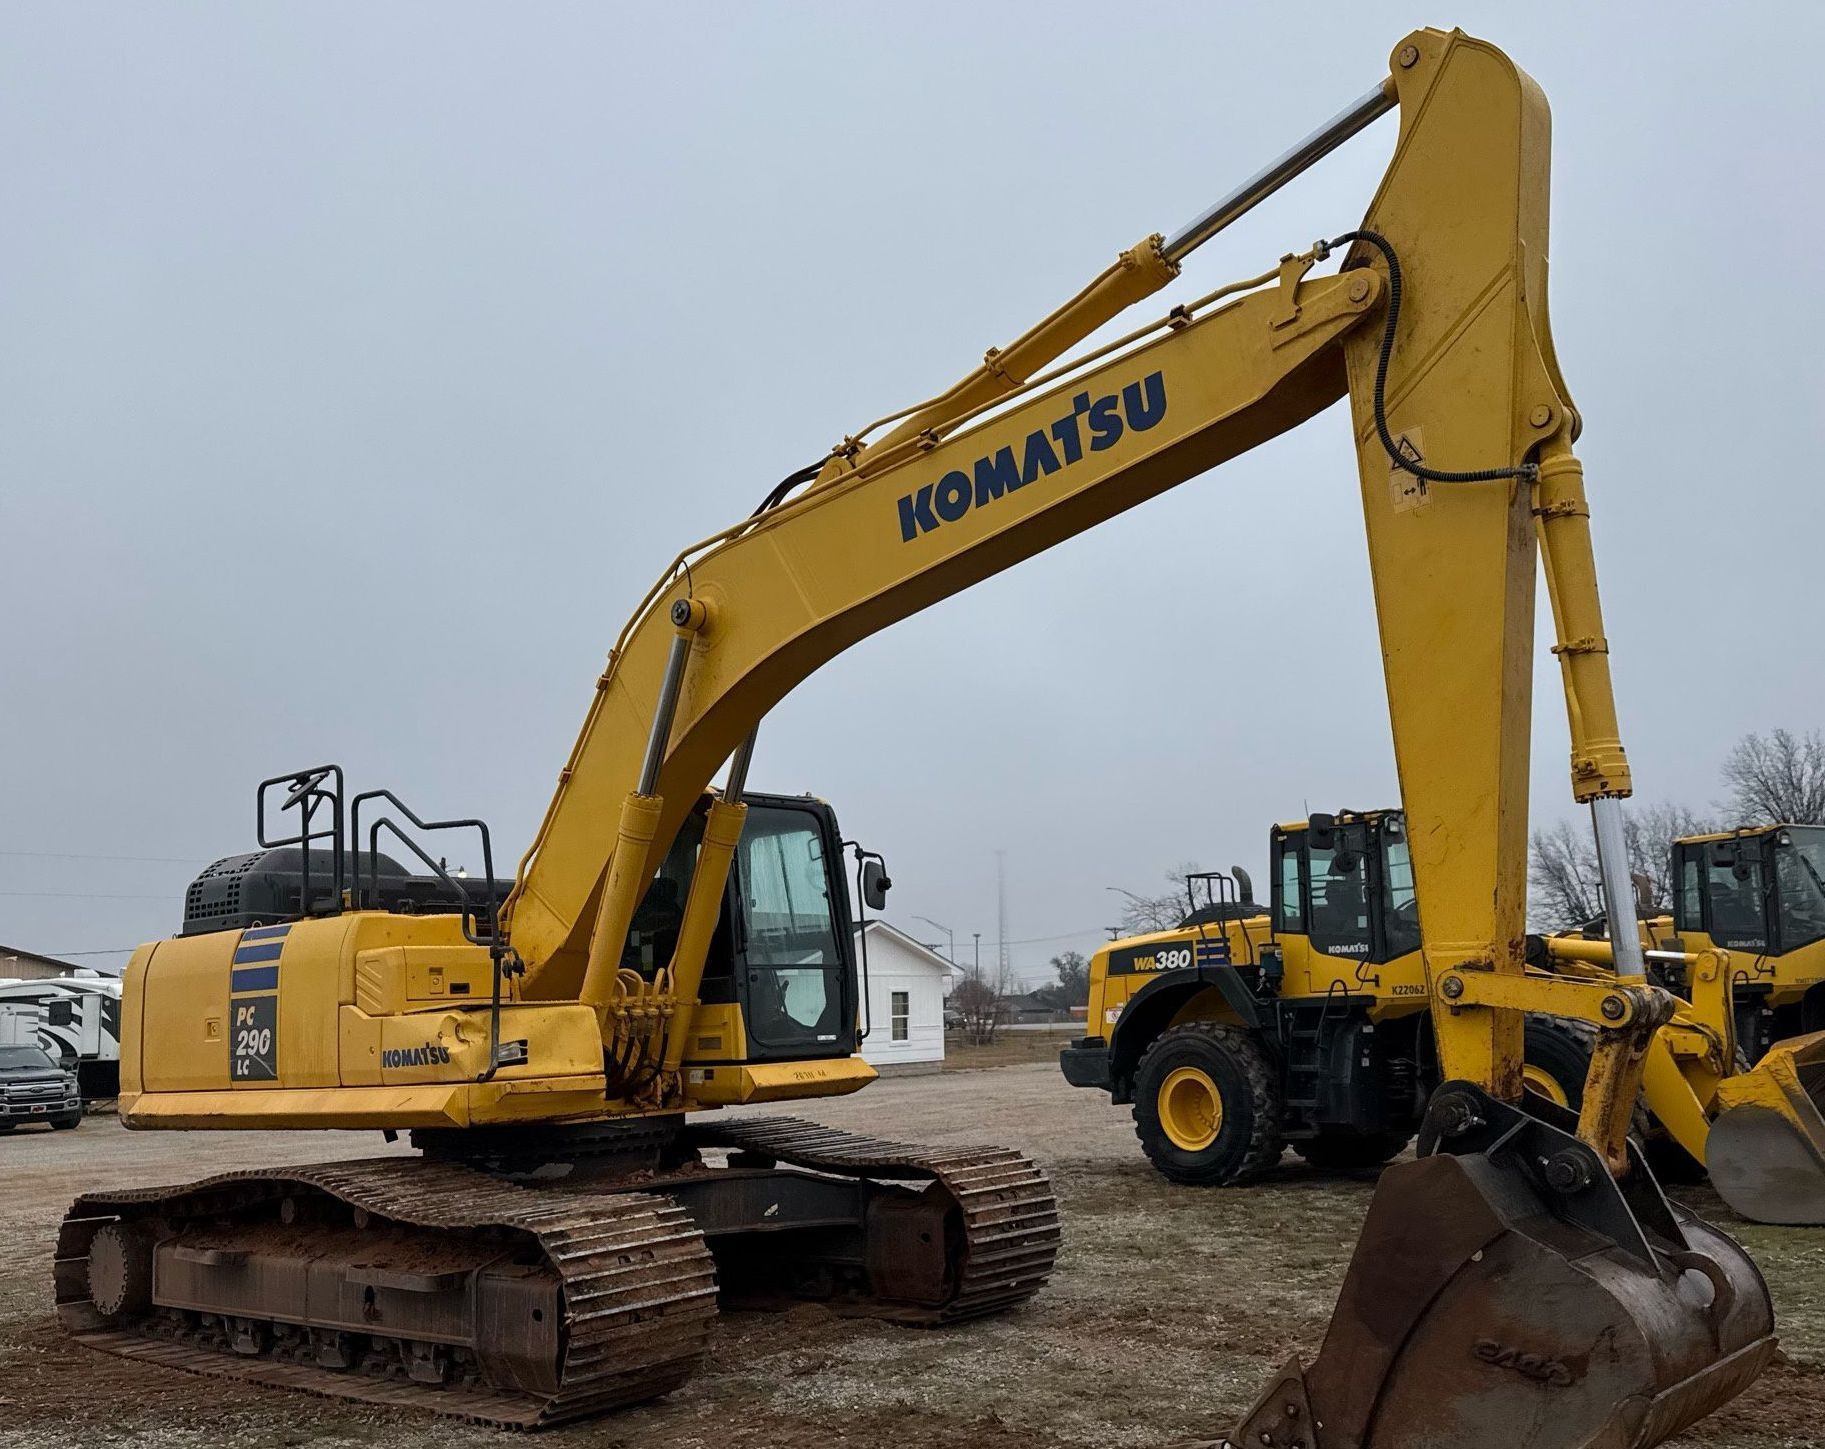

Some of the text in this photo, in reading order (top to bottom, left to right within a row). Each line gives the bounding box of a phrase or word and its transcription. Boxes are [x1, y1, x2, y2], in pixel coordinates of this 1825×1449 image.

[897, 370, 1167, 543] KOMATSU
[1133, 949, 1191, 970] WA380
[1391, 985, 1425, 995] K22062
[236, 1006, 256, 1027] PC
[235, 1028, 271, 1056] 290
[382, 1041, 451, 1068] KOMATSU
[236, 1059, 250, 1076] LC
